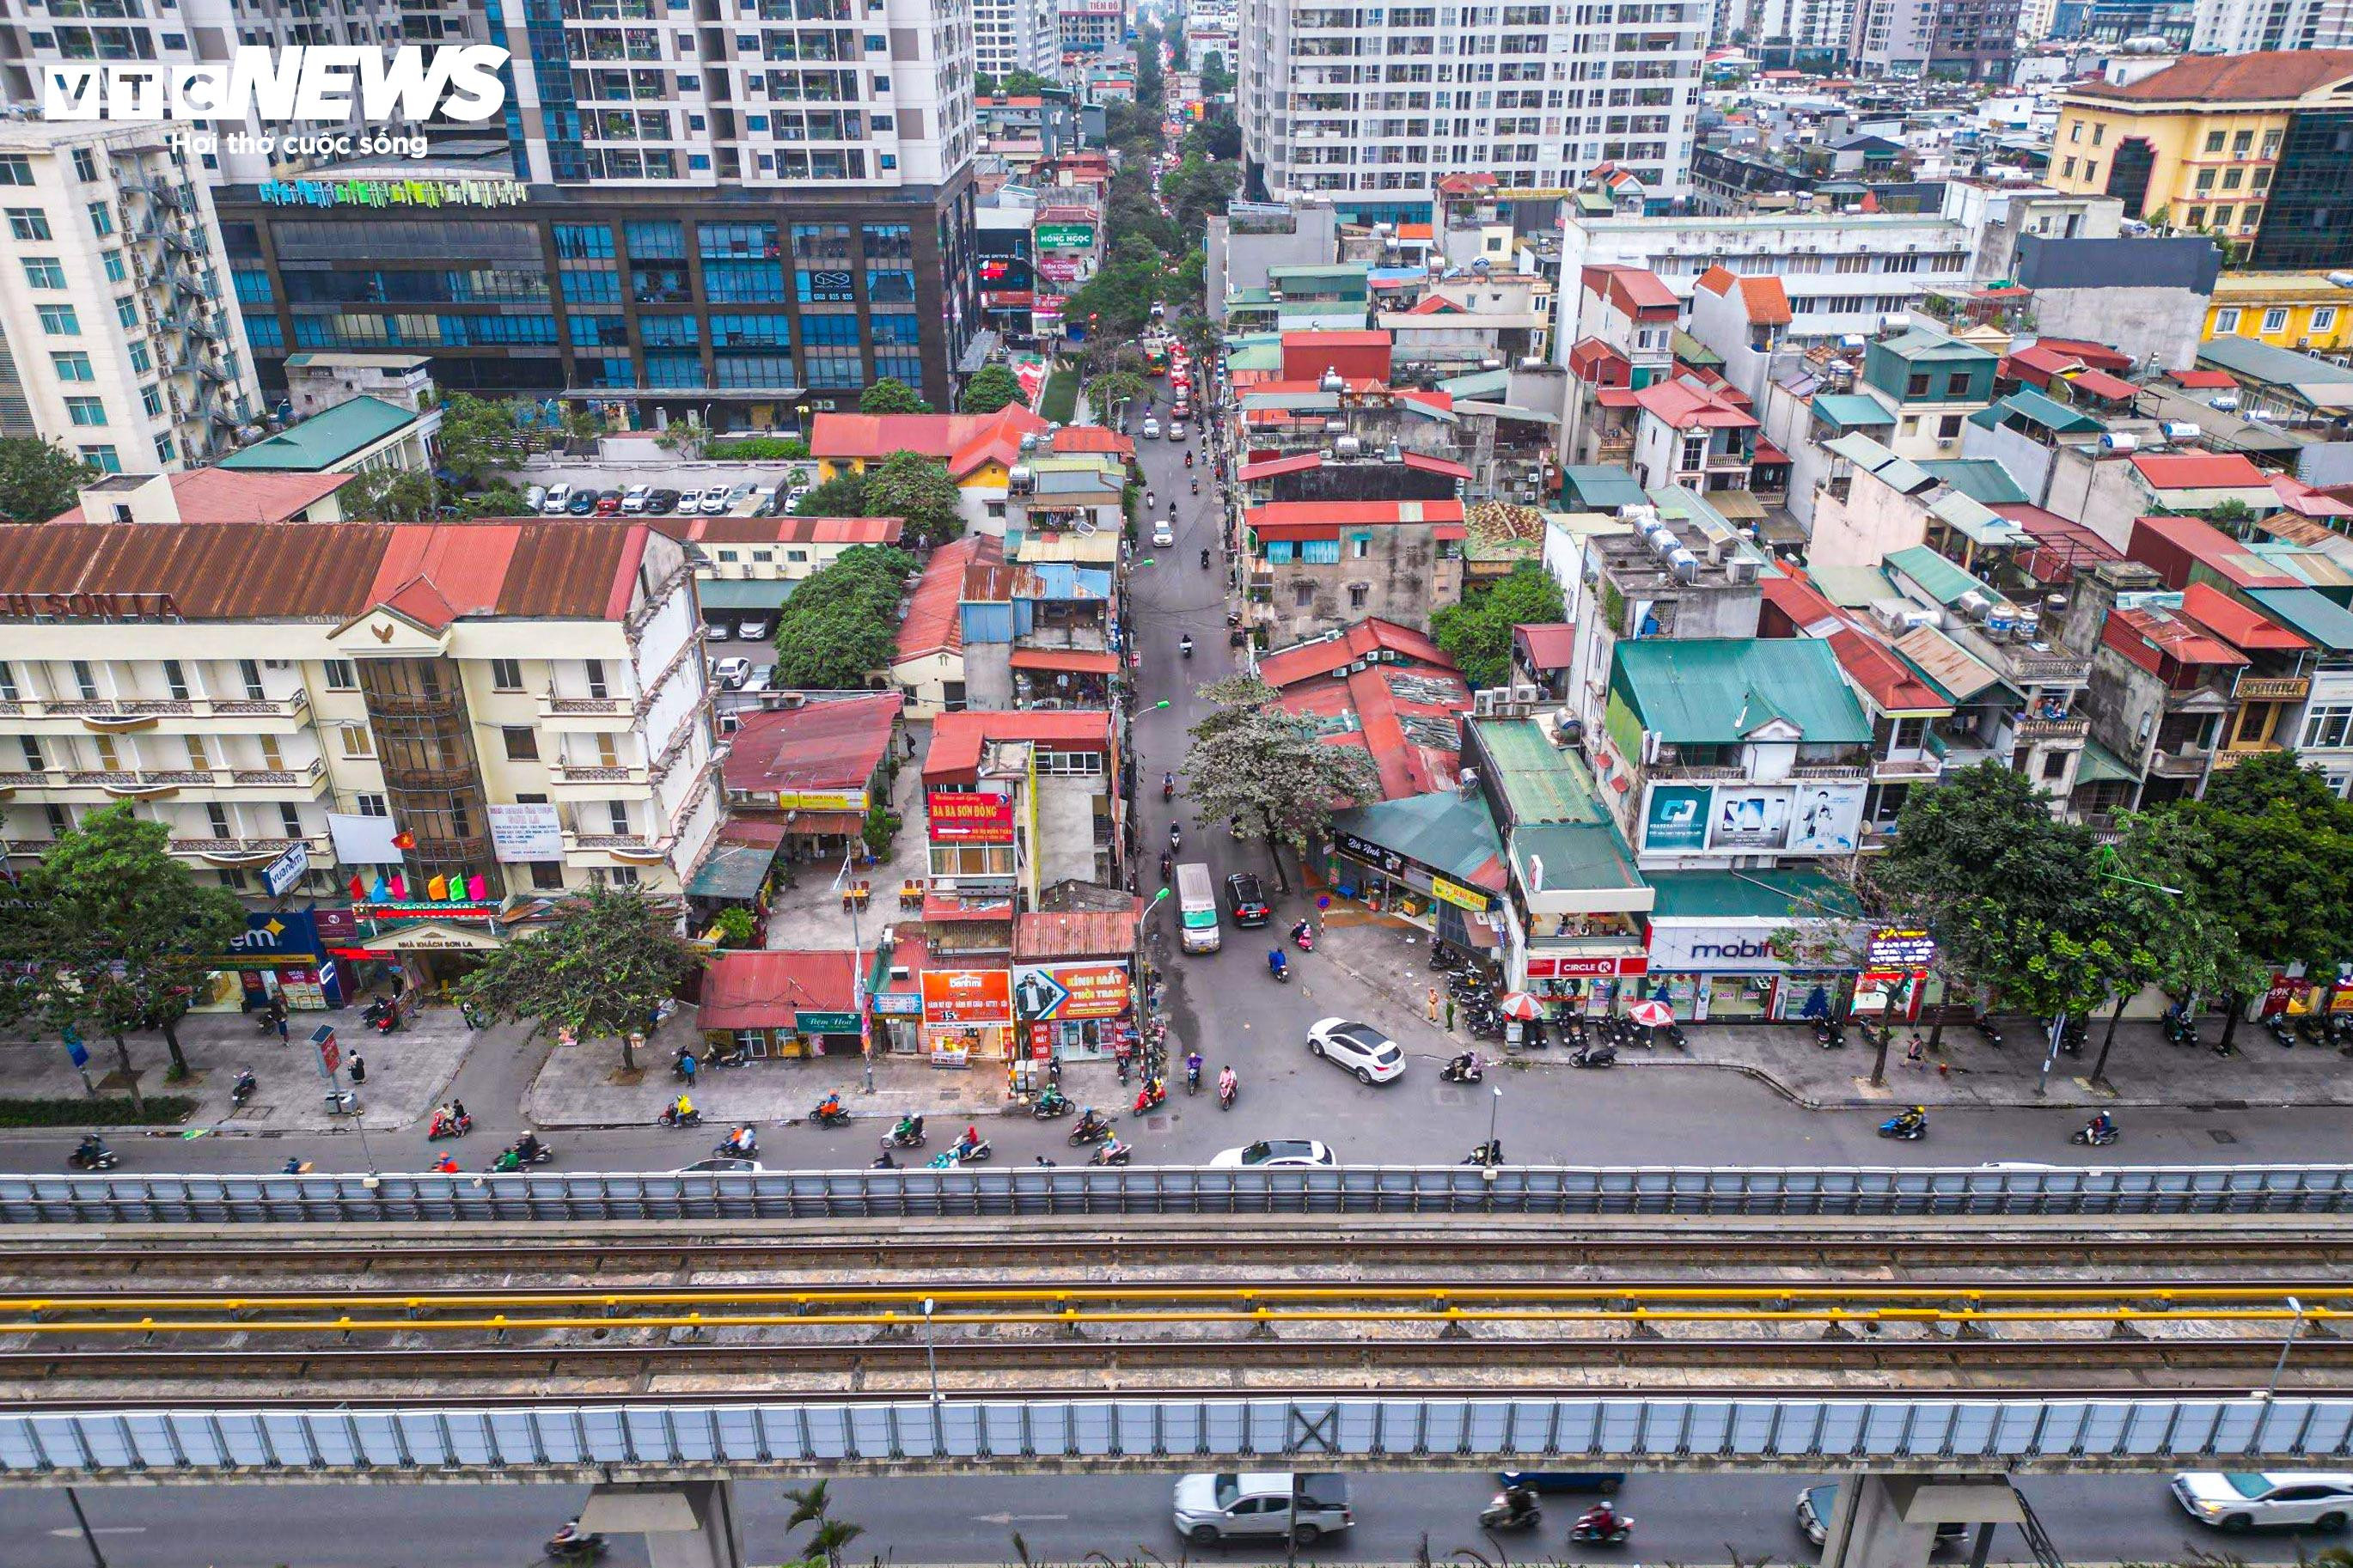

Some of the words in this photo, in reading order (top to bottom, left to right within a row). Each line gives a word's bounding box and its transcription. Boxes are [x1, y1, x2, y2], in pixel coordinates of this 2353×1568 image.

[932, 805, 944, 817] BA
[945, 805, 956, 817] BA
[2270, 987, 2290, 996] 49K
